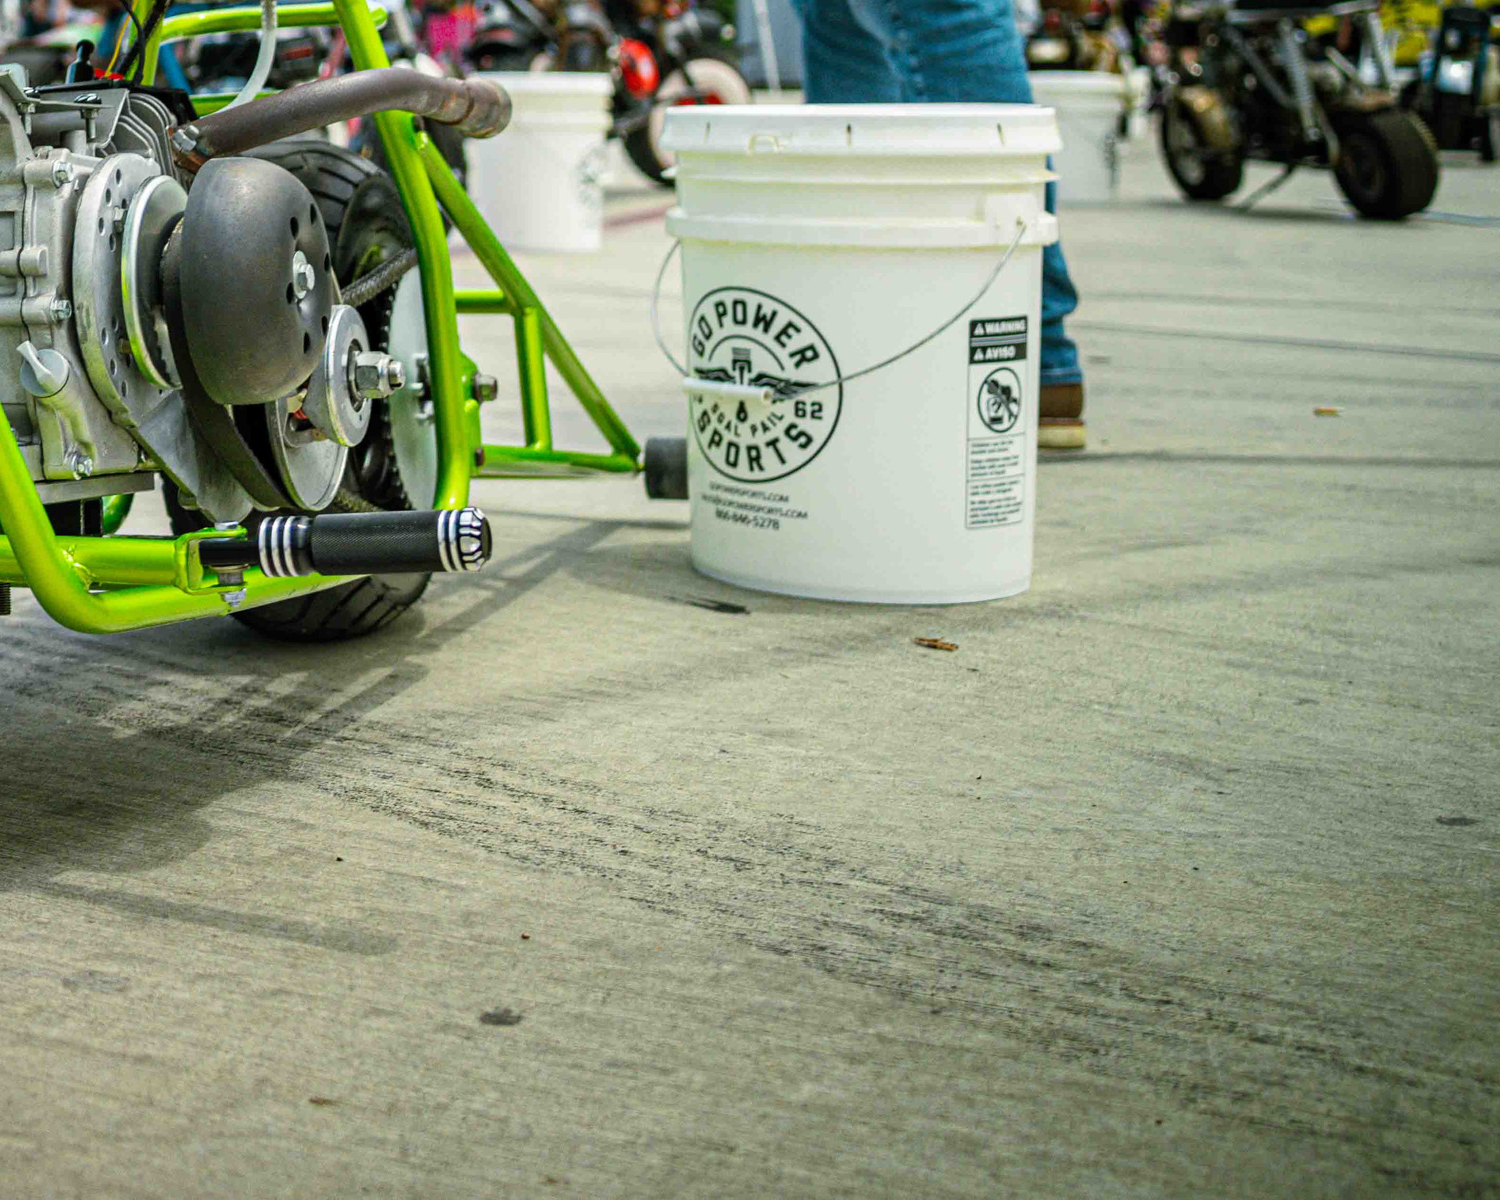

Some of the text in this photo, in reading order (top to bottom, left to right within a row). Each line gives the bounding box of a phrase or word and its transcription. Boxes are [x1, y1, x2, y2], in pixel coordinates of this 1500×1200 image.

[714, 298, 820, 369] POWER
[750, 412, 784, 437] PAIL
[793, 401, 823, 419] 62
[698, 409, 813, 472] SPORTS
